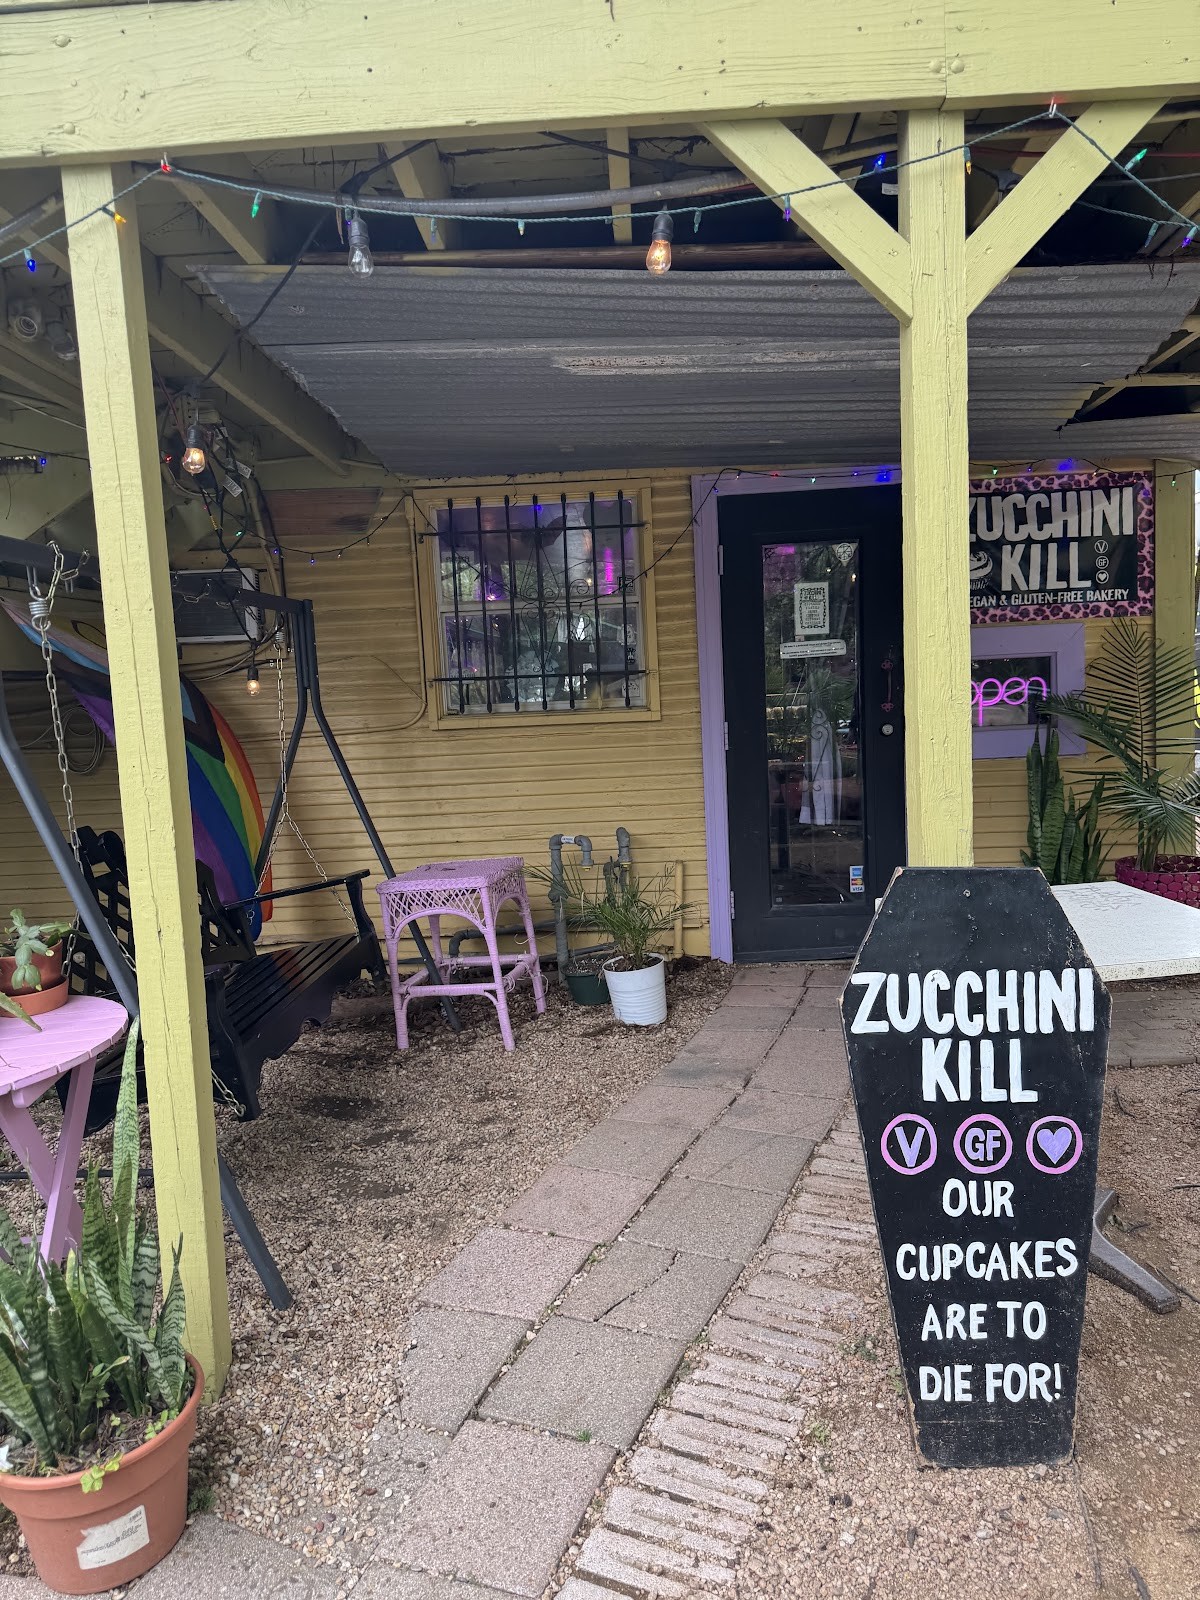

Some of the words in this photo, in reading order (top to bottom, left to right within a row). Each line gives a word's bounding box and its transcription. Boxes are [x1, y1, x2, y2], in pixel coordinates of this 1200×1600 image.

[1001, 542, 1091, 591] KILL
[1097, 542, 1106, 552] V
[1098, 558, 1107, 567] GF
[970, 595, 996, 608] EGAN
[1000, 594, 1008, 606] &
[1011, 590, 1083, 606] GLUTEN-FREE
[1087, 588, 1129, 602] BAKERY
[851, 968, 1094, 1037] ZUCCHINI
[921, 1038, 1039, 1103] KILL
[894, 1126, 926, 1168] V
[964, 1127, 1002, 1162] GF
[942, 1178, 1015, 1218] OUR
[896, 1237, 1078, 1282] CUPCAKES
[921, 1303, 988, 1341] ARE
[997, 1301, 1047, 1340] TO
[918, 1364, 973, 1402] DIE
[985, 1363, 1062, 1402] FOR!
